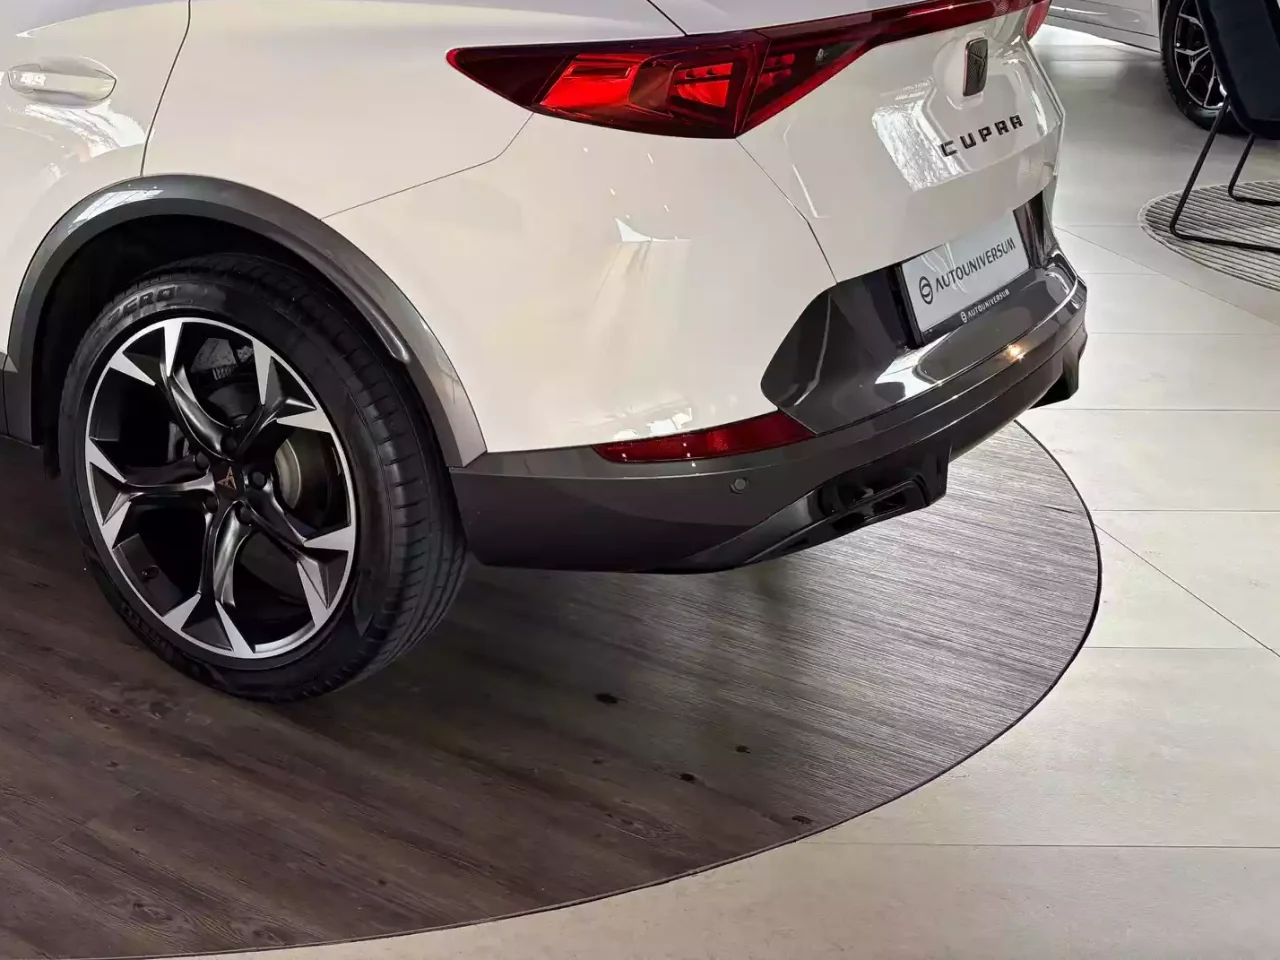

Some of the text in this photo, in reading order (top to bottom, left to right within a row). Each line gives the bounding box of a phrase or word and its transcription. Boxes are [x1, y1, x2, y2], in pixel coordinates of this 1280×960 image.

[939, 114, 1024, 157] CUPRA
[935, 237, 1016, 293] AUTOUNIVERSUM
[966, 288, 1011, 319] AUTOUNIVERSUM
